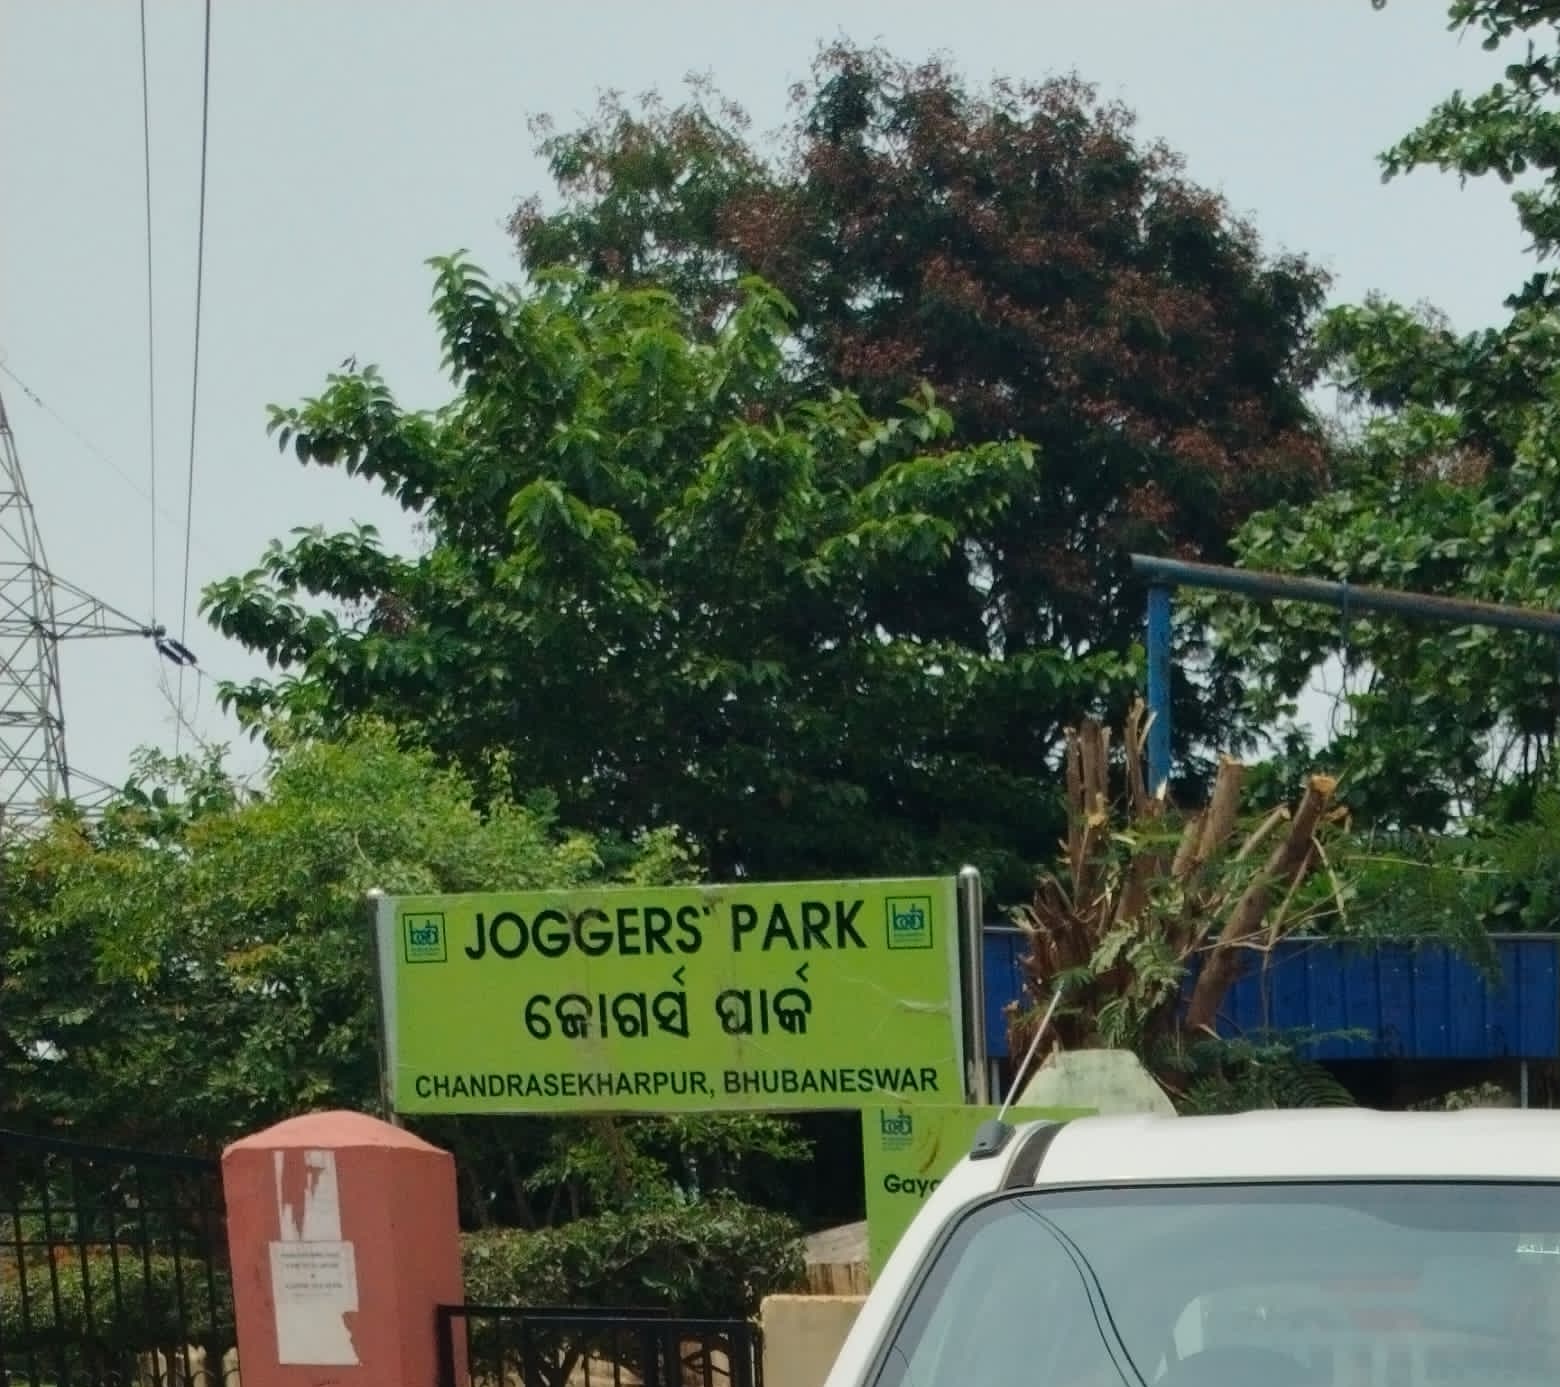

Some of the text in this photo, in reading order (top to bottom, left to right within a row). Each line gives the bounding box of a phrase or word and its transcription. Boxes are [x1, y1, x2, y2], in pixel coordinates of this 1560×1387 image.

[465, 900, 867, 960] JOGGERS' PARK
[715, 961, 812, 1036] ପାର୍କ
[415, 1067, 938, 1099] CHANDRASEKHARPUR, BHUBANESWAR
